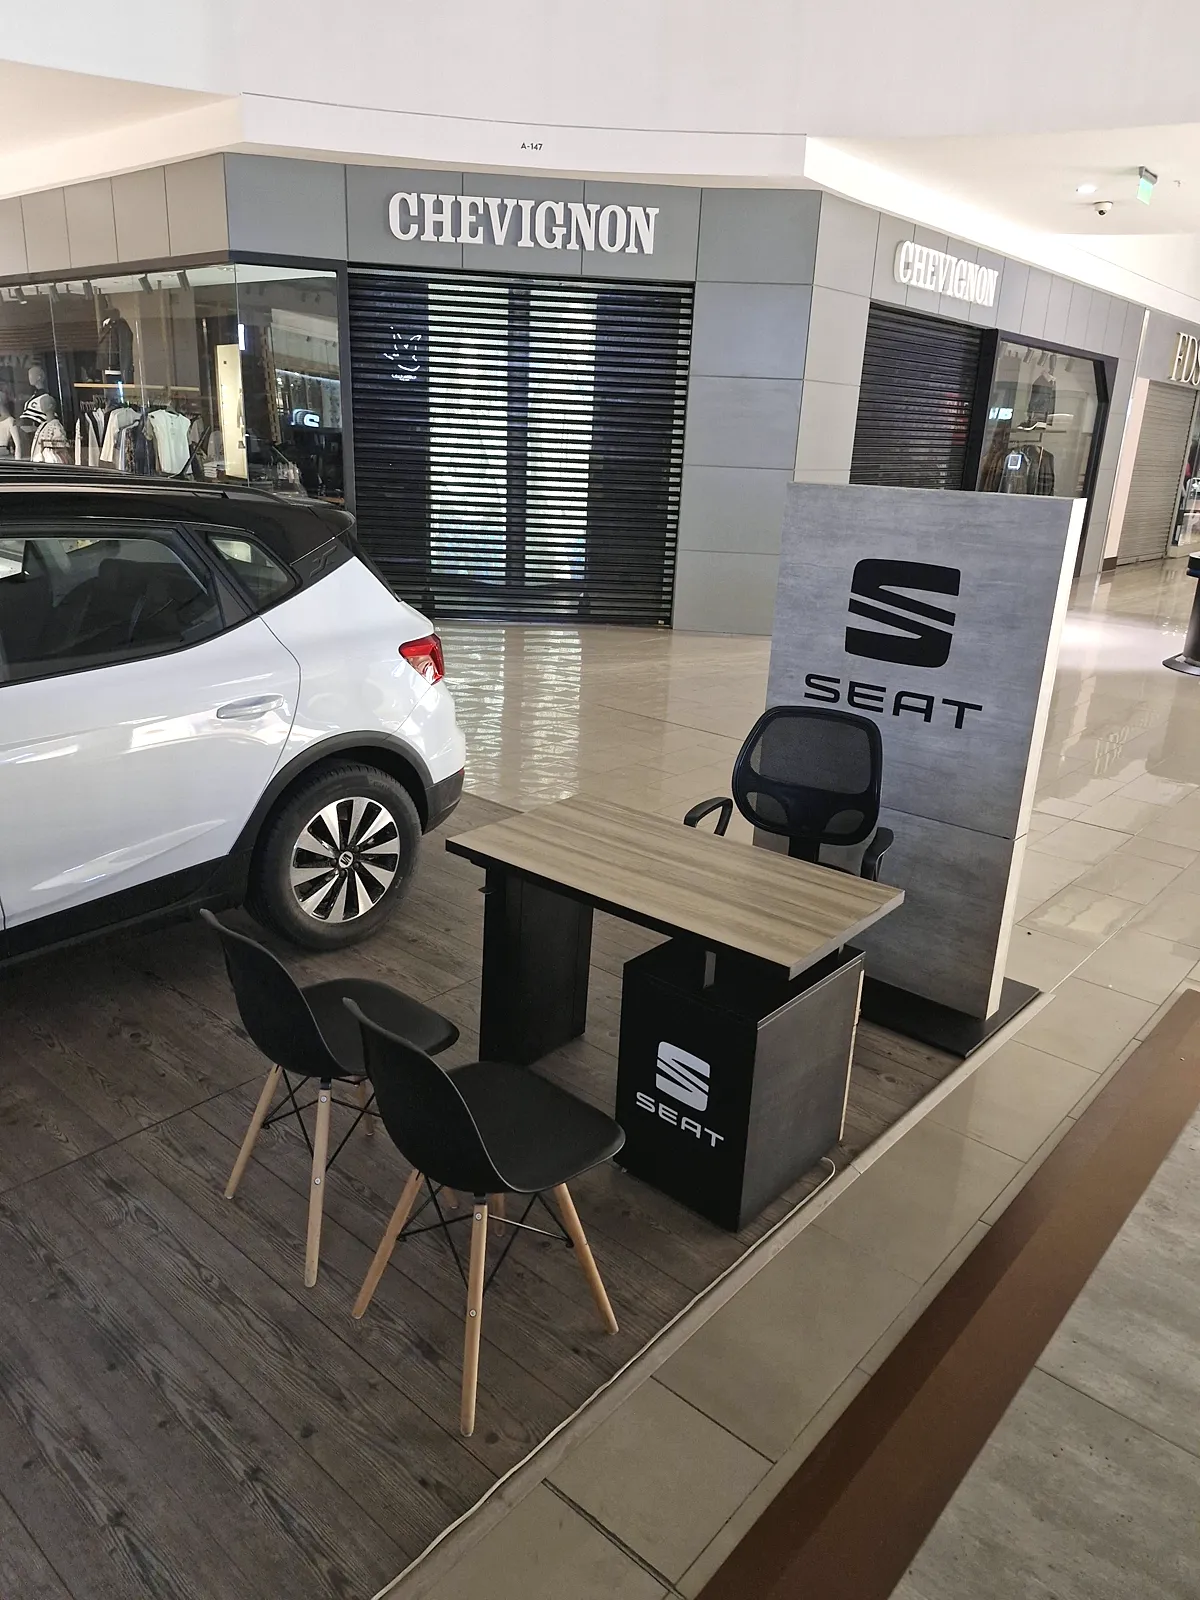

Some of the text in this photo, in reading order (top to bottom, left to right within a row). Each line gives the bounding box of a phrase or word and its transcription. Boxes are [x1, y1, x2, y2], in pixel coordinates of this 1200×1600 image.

[520, 142, 543, 151] A-147
[388, 191, 660, 255] CHEVIGNON
[898, 240, 999, 307] CHEVIGNON
[804, 673, 983, 729] SEAT
[636, 1091, 725, 1148] SEAT
